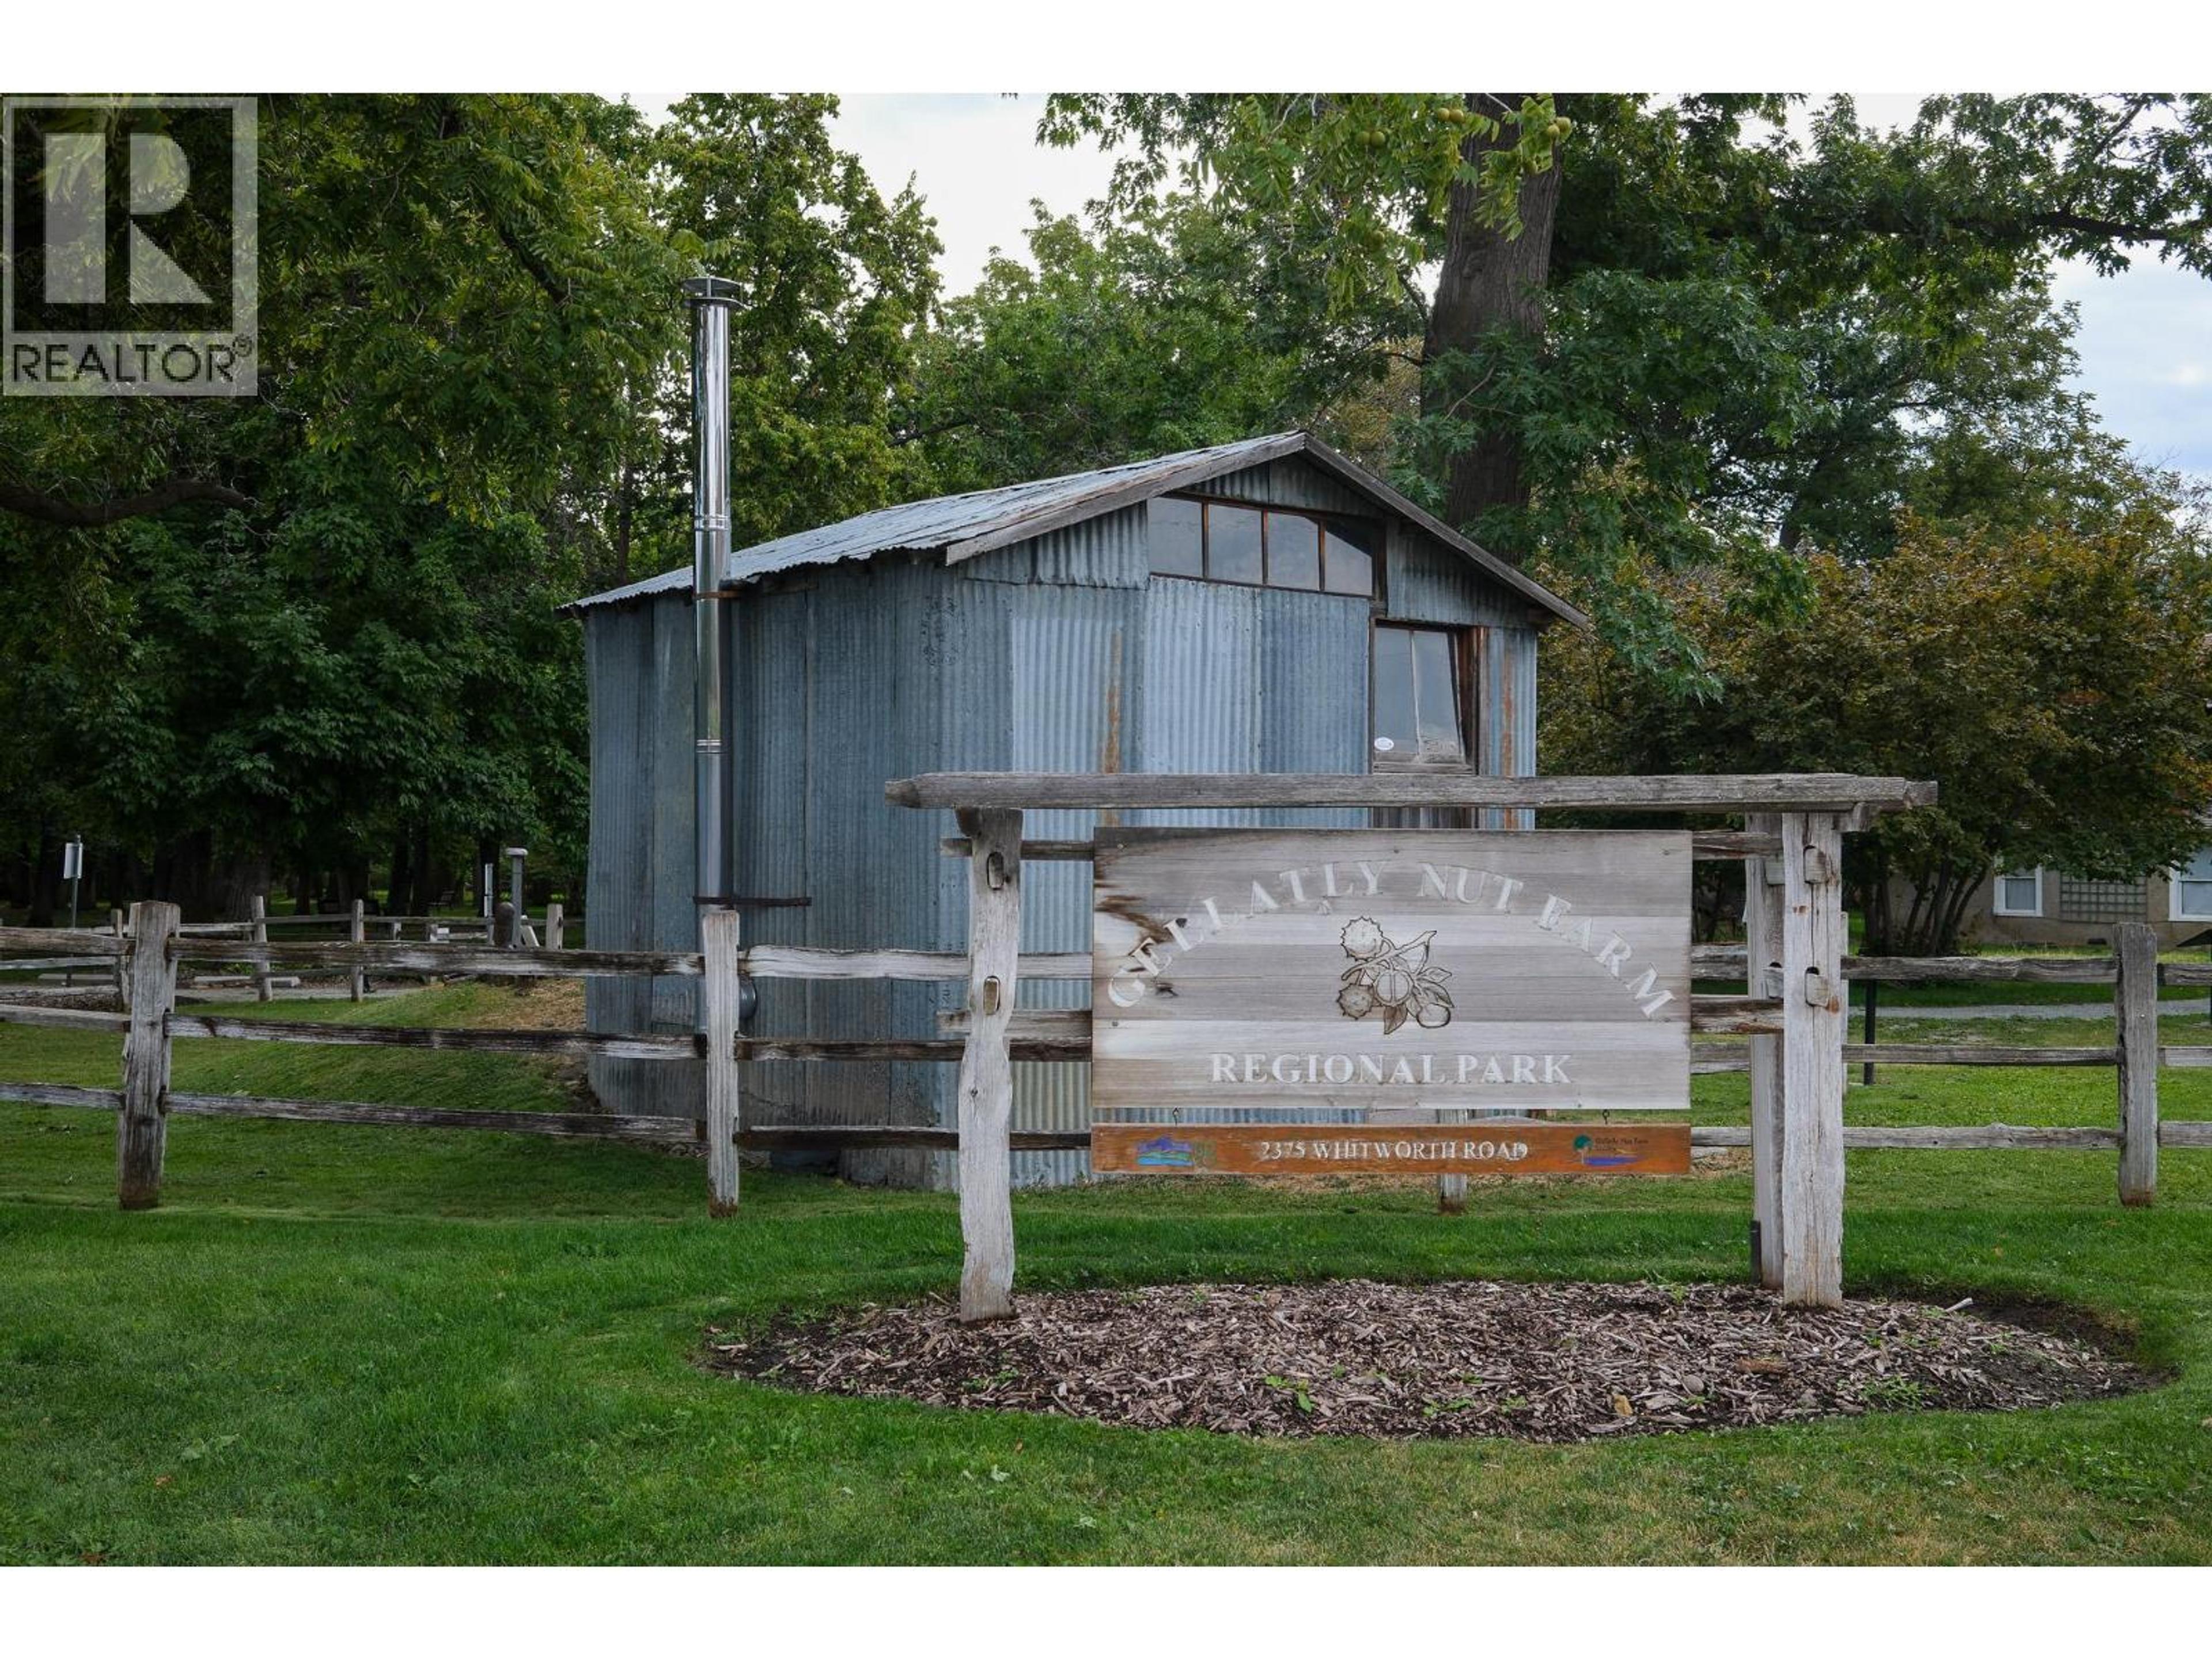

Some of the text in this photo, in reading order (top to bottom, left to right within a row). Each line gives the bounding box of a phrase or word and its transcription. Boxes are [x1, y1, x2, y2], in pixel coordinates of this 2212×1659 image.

[1108, 861, 1677, 1018] GELLATLY NUT FARM
[1210, 1052, 1573, 1085] REGIONAL PARK
[1259, 1140, 1528, 1160] 2375 WHITWORTH ROAD
